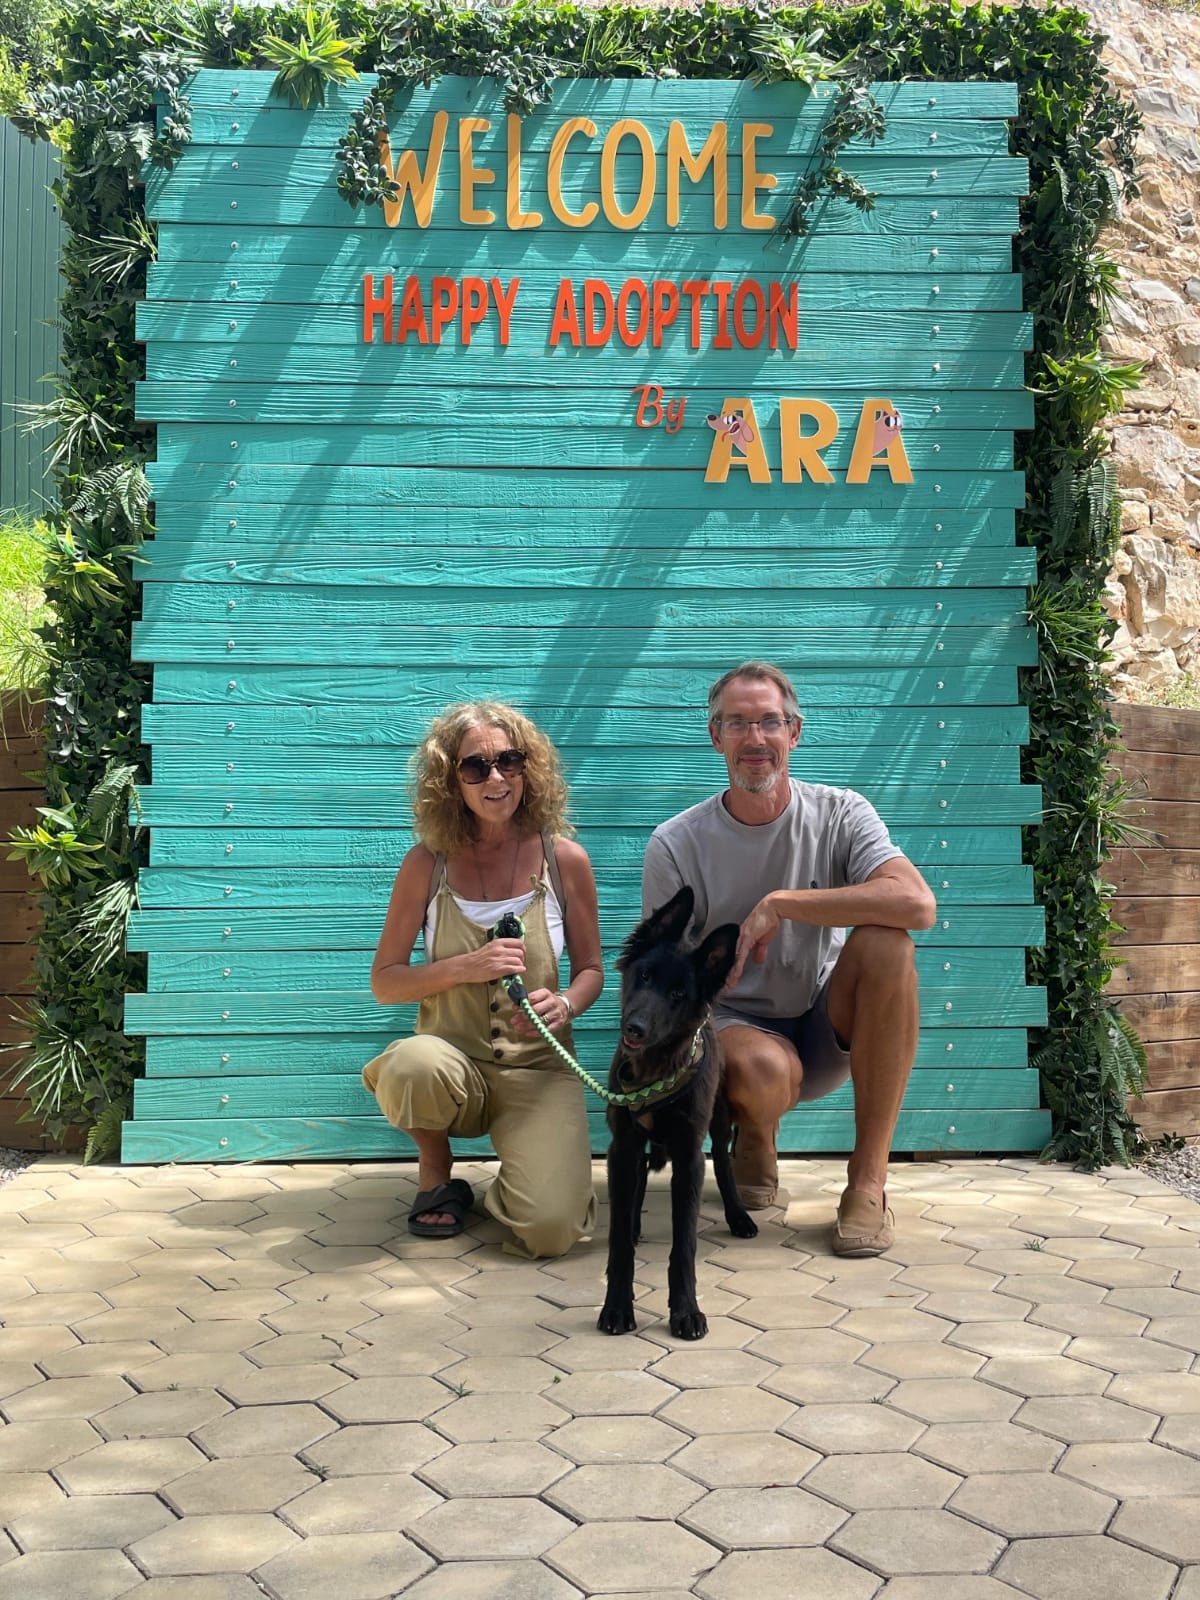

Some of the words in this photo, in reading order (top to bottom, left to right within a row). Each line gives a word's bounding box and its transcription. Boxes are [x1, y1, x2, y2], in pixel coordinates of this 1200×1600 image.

[380, 110, 779, 230] WELCOME
[362, 274, 521, 346] HAPPY
[549, 277, 799, 351] ADOPTION
[631, 384, 687, 434] By
[703, 397, 914, 484] ARA
